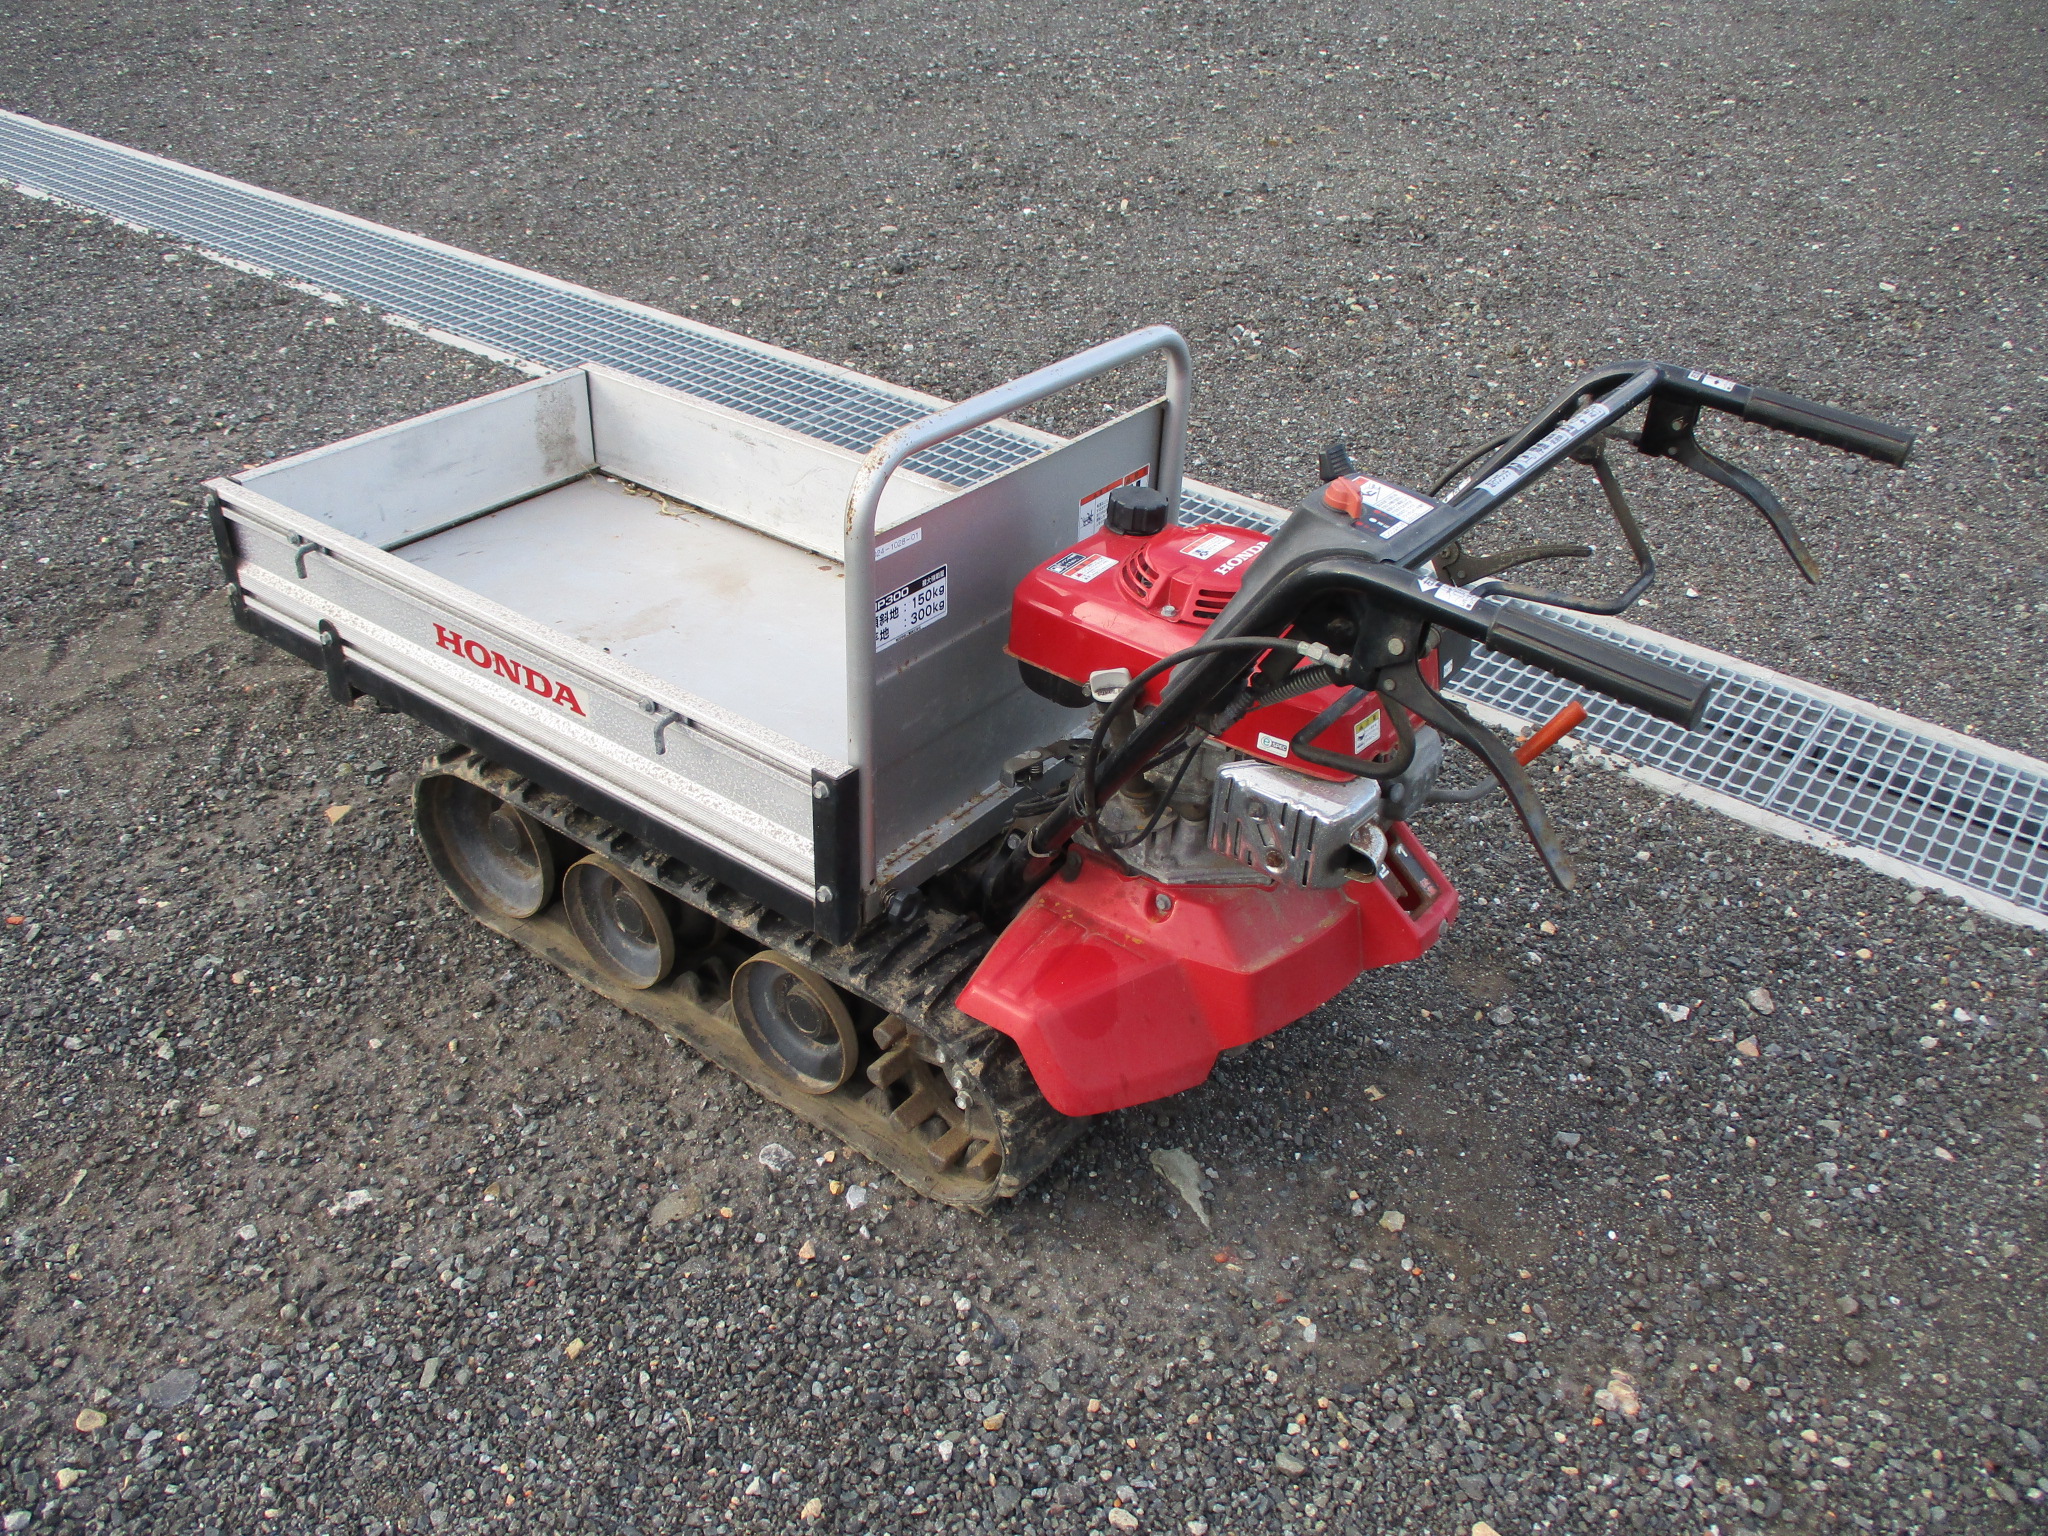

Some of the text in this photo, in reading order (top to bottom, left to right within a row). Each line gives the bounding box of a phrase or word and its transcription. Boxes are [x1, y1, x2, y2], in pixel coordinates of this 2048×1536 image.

[1214, 541, 1269, 576] HONDA
[875, 586, 909, 612] P300
[912, 584, 945, 610] 150kg
[910, 599, 945, 625] 300kg
[433, 623, 587, 717] HONDA
[1379, 863, 1390, 879] 2
